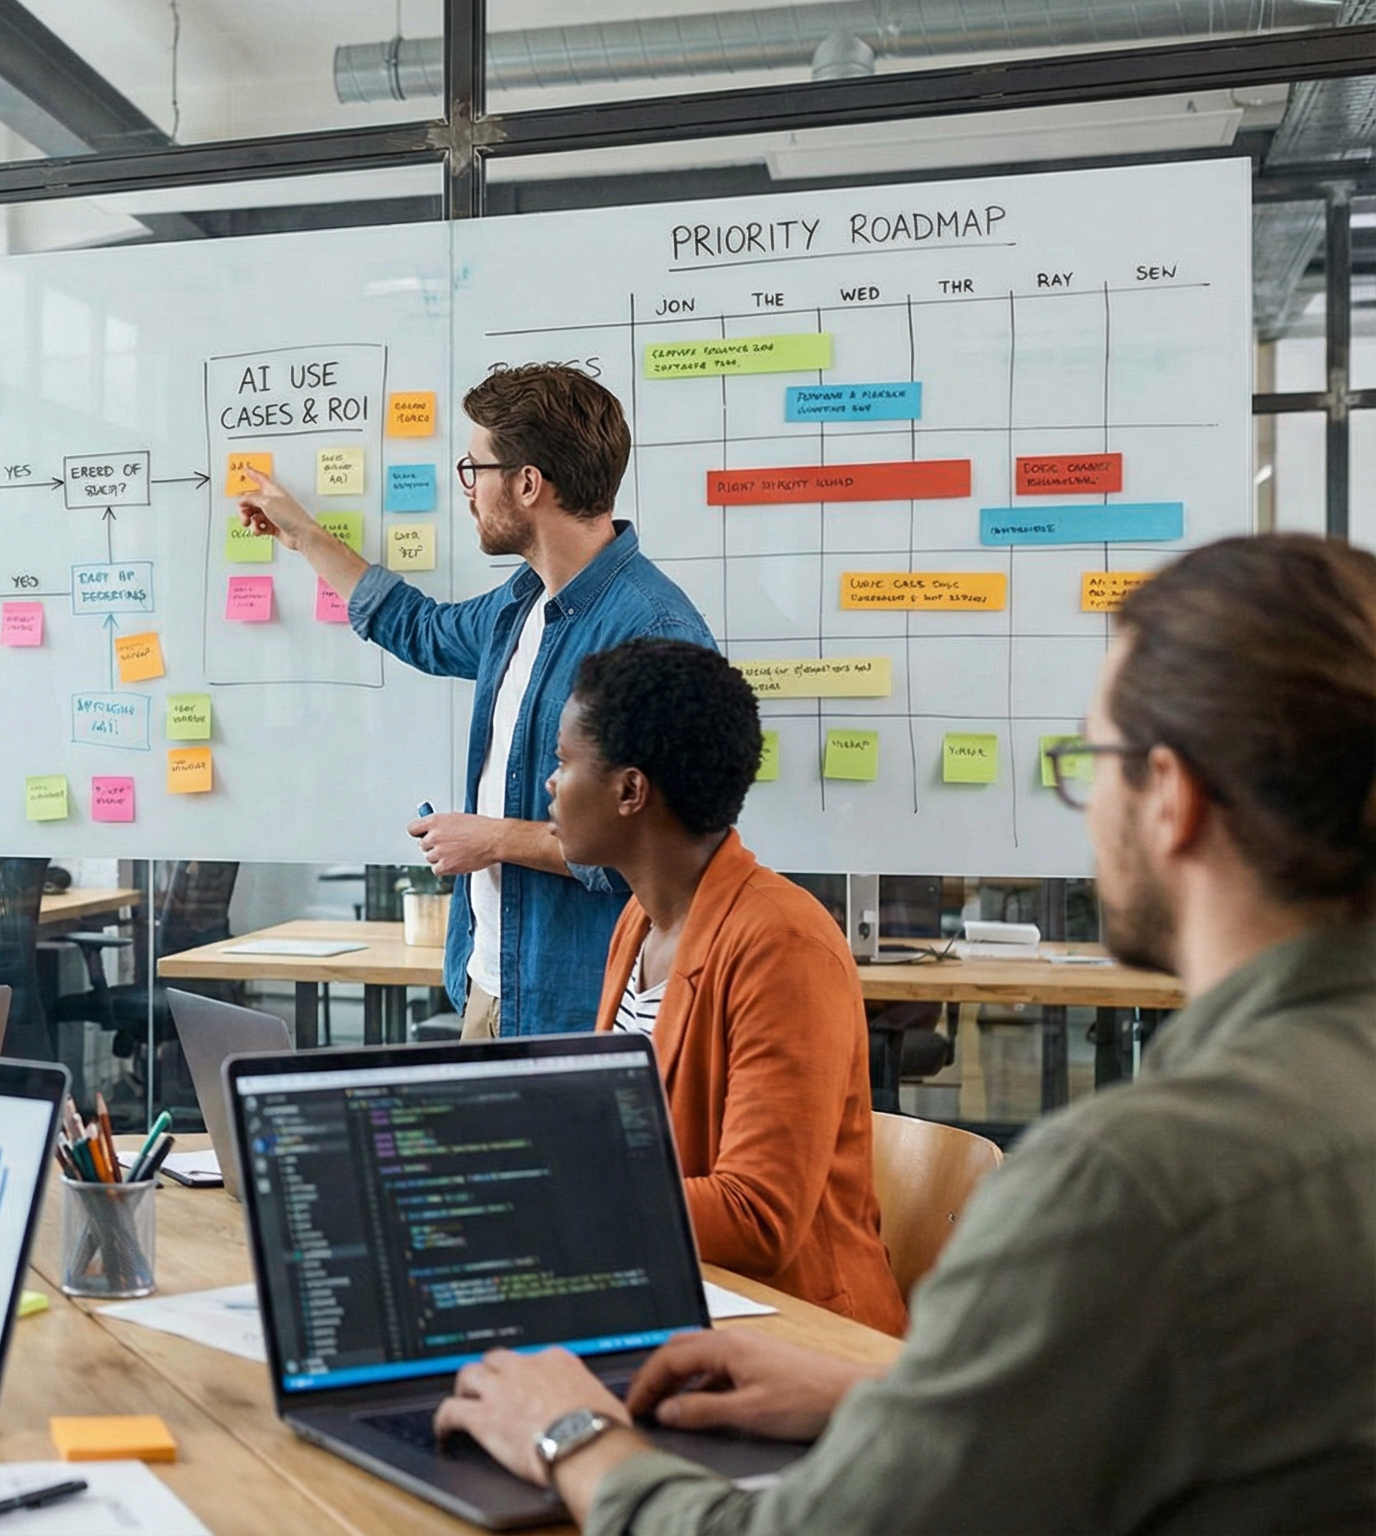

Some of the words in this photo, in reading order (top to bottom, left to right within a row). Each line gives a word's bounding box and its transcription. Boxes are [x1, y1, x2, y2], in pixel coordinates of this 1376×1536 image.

[671, 218, 821, 260] PRIORITY
[850, 205, 1006, 244] ROADMAP
[655, 297, 695, 315] JON
[751, 292, 785, 307] THE
[840, 286, 880, 302] WED
[938, 279, 974, 294] THR
[1037, 272, 1074, 288] RAY
[238, 365, 271, 395] AI
[290, 361, 340, 389] USE
[220, 402, 294, 430] CASES
[301, 397, 319, 425] &
[328, 395, 368, 423] ROI
[4, 464, 32, 480] YES
[123, 463, 142, 477] OF
